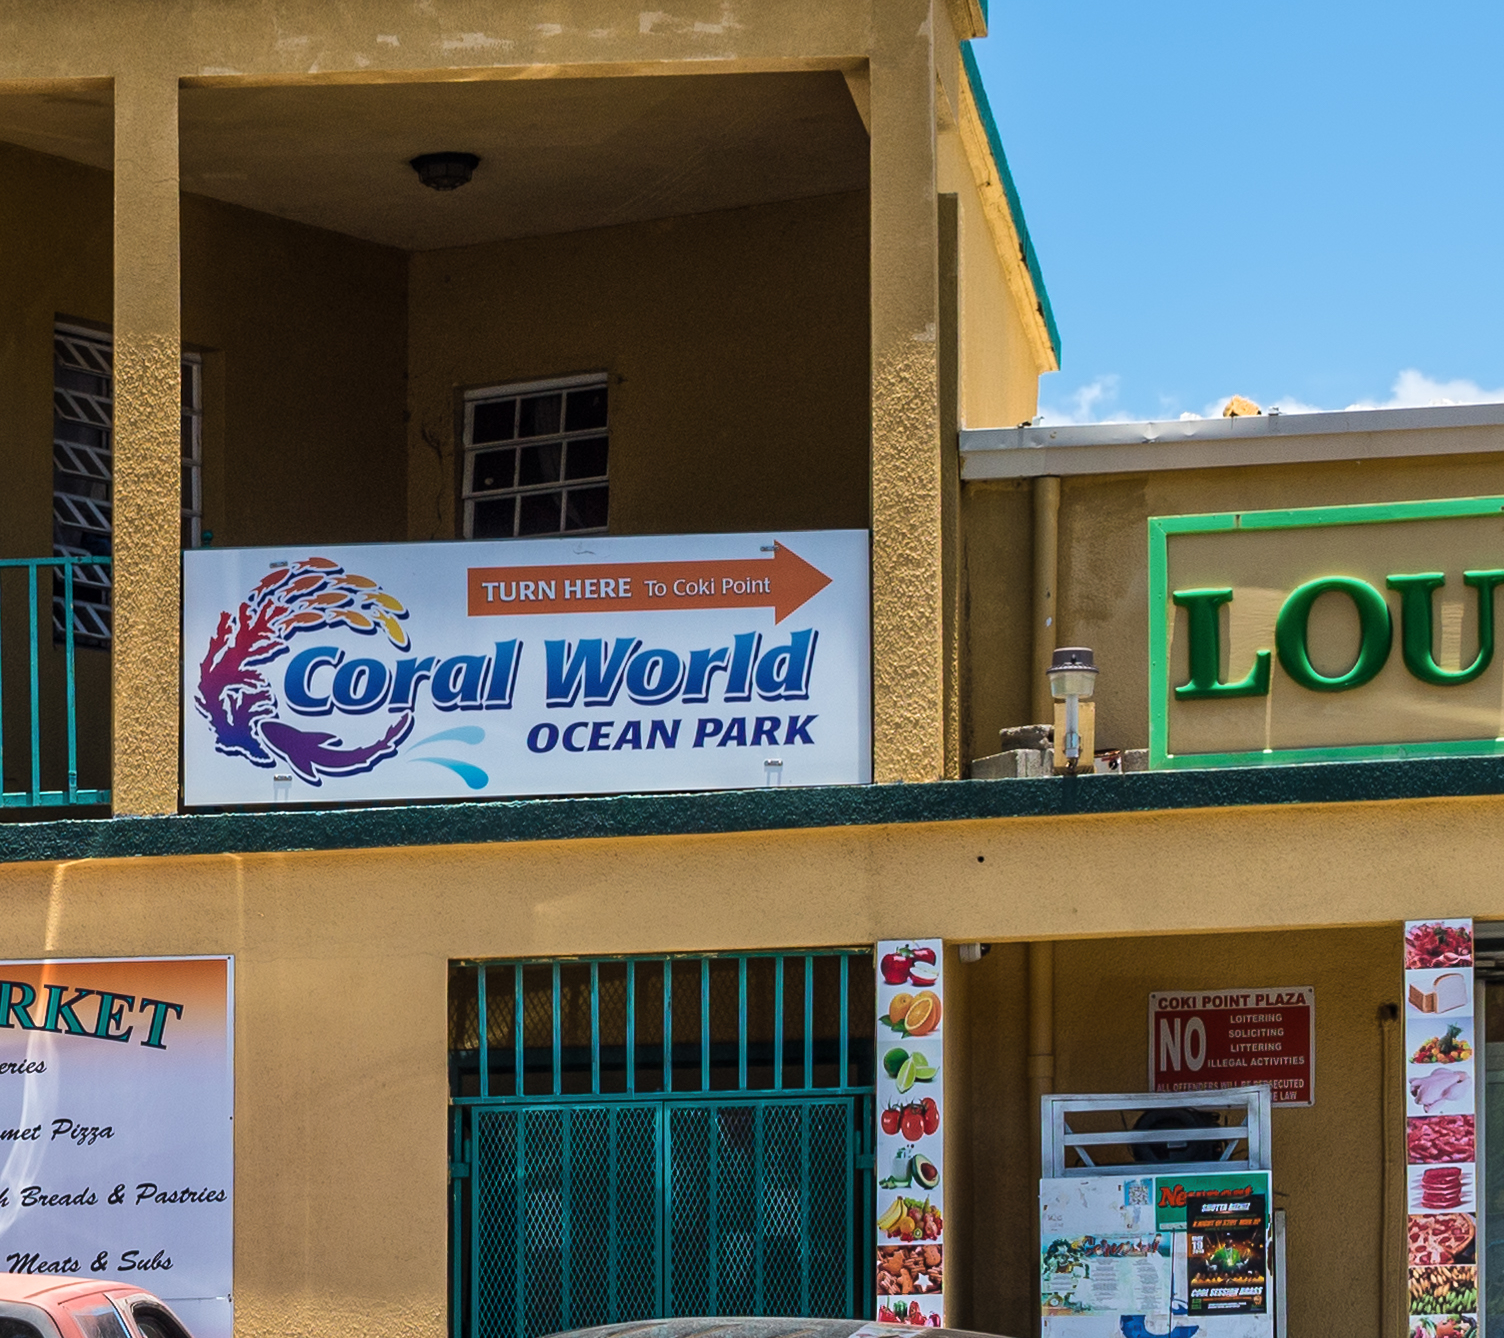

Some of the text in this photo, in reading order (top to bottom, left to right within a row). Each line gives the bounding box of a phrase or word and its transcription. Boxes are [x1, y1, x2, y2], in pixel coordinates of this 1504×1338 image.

[482, 574, 771, 603] TURN HERE To Coki Point
[284, 628, 815, 715] Coral World
[526, 714, 819, 754] OCEAN PARK
[1158, 993, 1306, 1009] COKI POINT PLAZA
[1230, 1014, 1282, 1024] LOITERING
[1160, 1016, 1207, 1072] NO
[1229, 1028, 1284, 1038] SOLICITING
[1230, 1043, 1282, 1052] LITTERING
[1208, 1056, 1305, 1067] ILLEGAL ACTIVITIES
[50, 1120, 115, 1146] Pizza
[22, 1185, 100, 1211] Breads
[108, 1183, 126, 1206] &
[134, 1183, 228, 1209] Pastries
[3, 1252, 84, 1275] Meats
[90, 1250, 110, 1273] &
[116, 1248, 173, 1272] Subs
